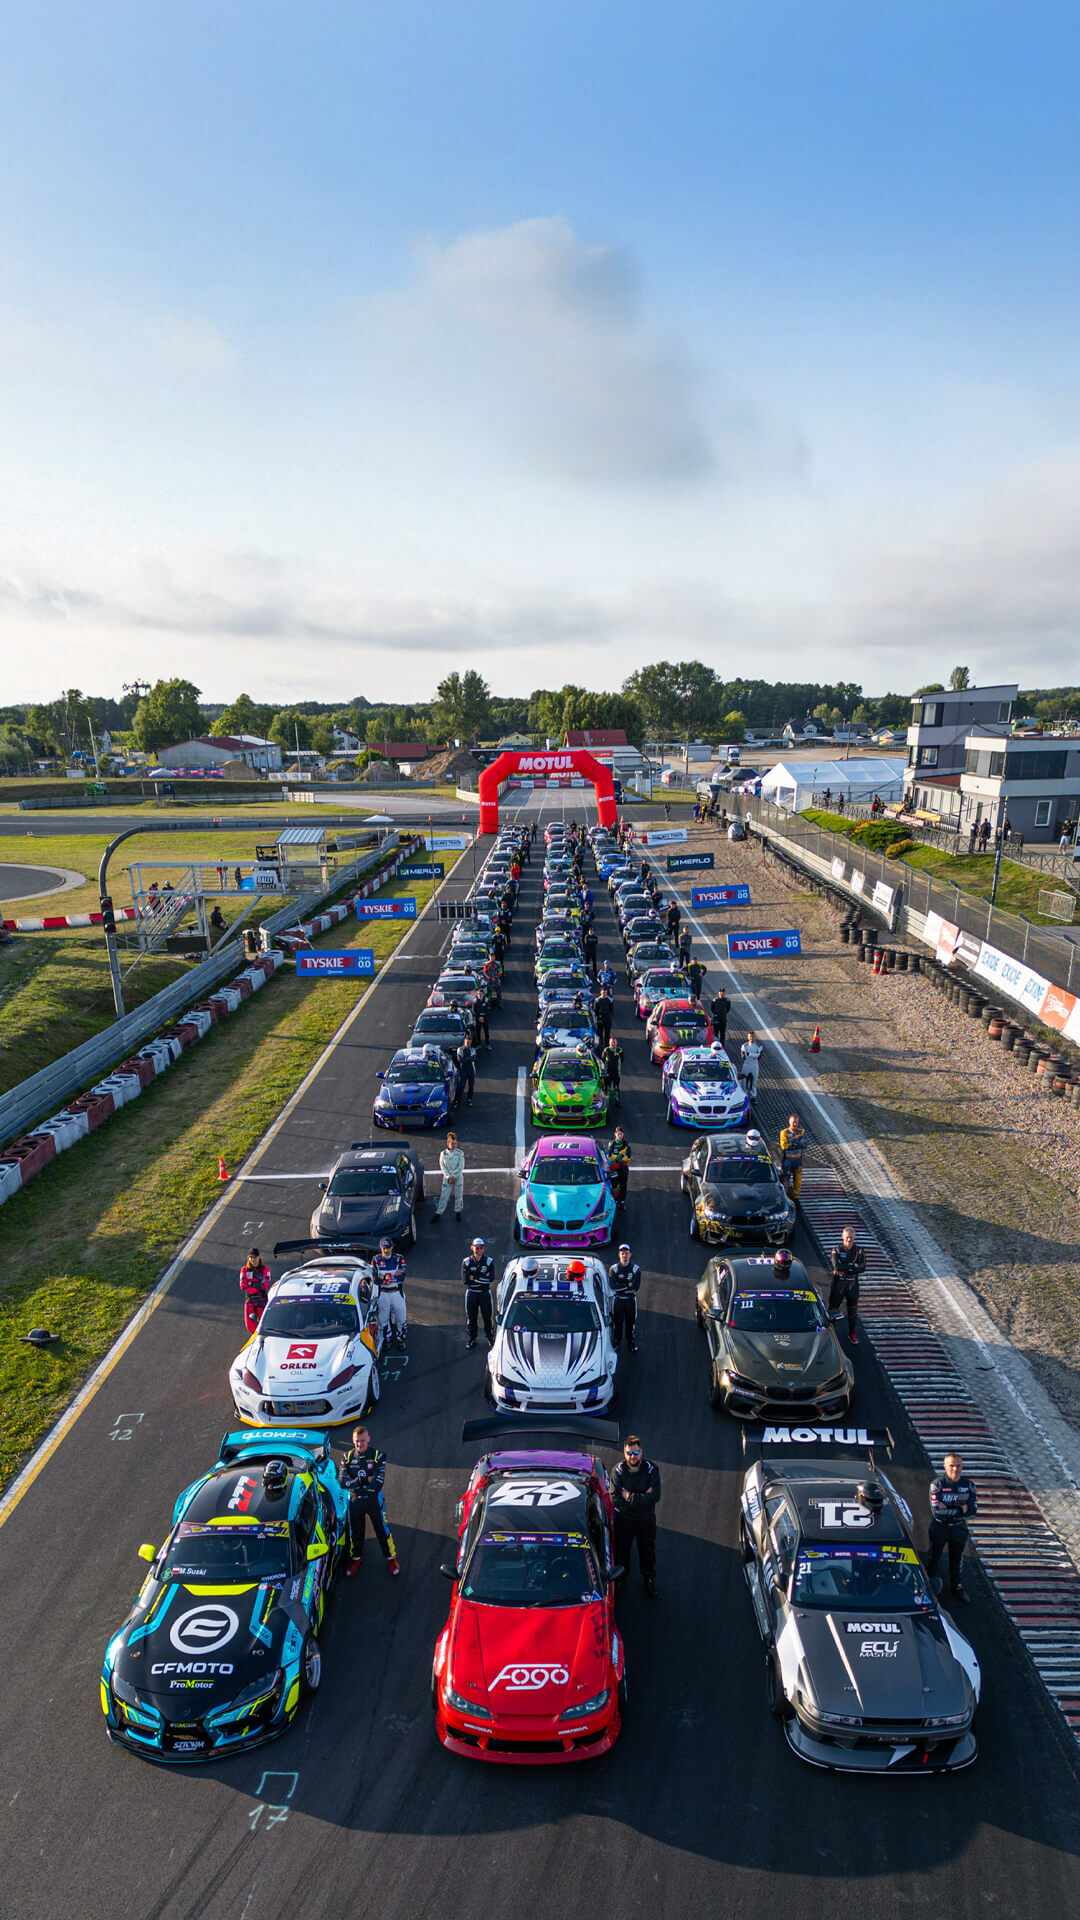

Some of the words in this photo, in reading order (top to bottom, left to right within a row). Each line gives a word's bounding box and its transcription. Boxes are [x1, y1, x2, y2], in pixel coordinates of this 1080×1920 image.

[518, 756, 574, 770] MOTUL
[680, 857, 710, 865] MERLO
[410, 867, 441, 875] MERLO
[698, 891, 728, 901] TYSKIE
[364, 904, 394, 913] TYSKIE
[735, 938, 773, 950] TYSKIE
[304, 957, 344, 968] TYSKIE
[1001, 963, 1022, 985] EXIDE
[1024, 977, 1045, 1002] EXIDE
[557, 1093, 583, 1103] IPS
[319, 1284, 341, 1293] 98
[740, 1300, 754, 1309] 111
[280, 1362, 317, 1370] ORLEN
[109, 1429, 132, 1441] 12
[242, 1431, 308, 1440] CFMOTO
[762, 1427, 874, 1445] MOTUL
[227, 1475, 258, 1512] 277
[745, 1488, 762, 1519] MOTUL
[817, 1502, 873, 1527] 21
[799, 1562, 813, 1574] 21
[847, 1623, 901, 1633] MOTUL
[860, 1640, 900, 1653] ECU
[151, 1662, 234, 1675] CFMOTO
[169, 1679, 214, 1689] ProMotor
[249, 1804, 289, 1831] 17
